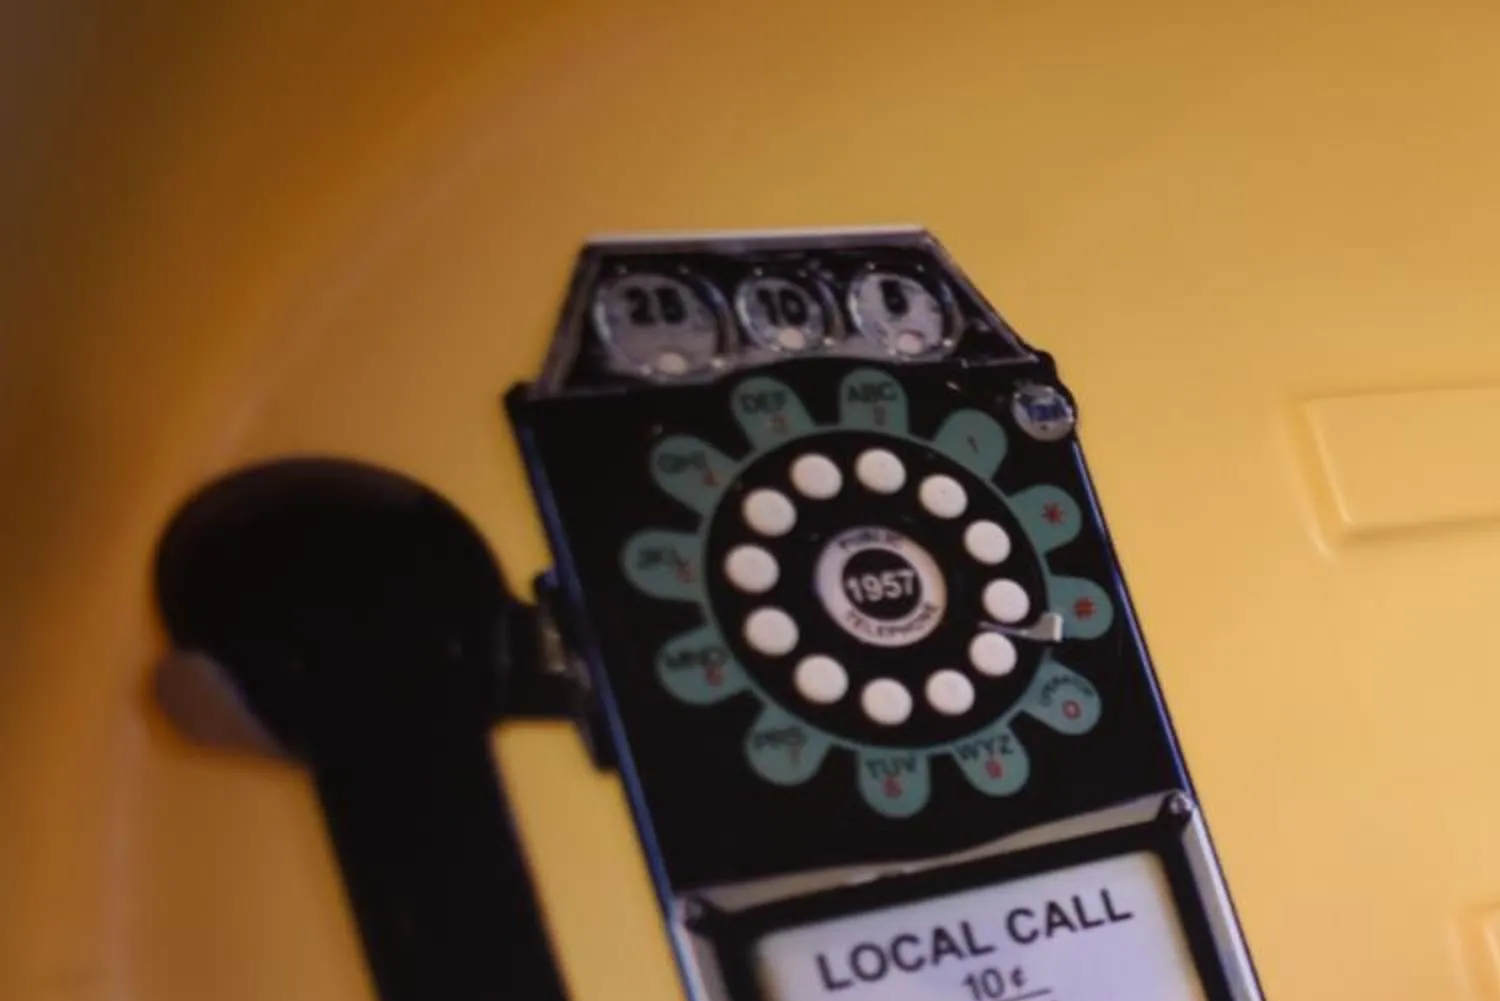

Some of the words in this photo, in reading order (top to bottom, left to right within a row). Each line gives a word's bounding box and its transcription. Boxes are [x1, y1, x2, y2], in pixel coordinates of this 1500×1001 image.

[756, 287, 808, 327] 10
[847, 381, 898, 403] ABC
[846, 568, 915, 604] 1957
[815, 920, 995, 993] LOCAL
[1004, 887, 1136, 945] CALL
